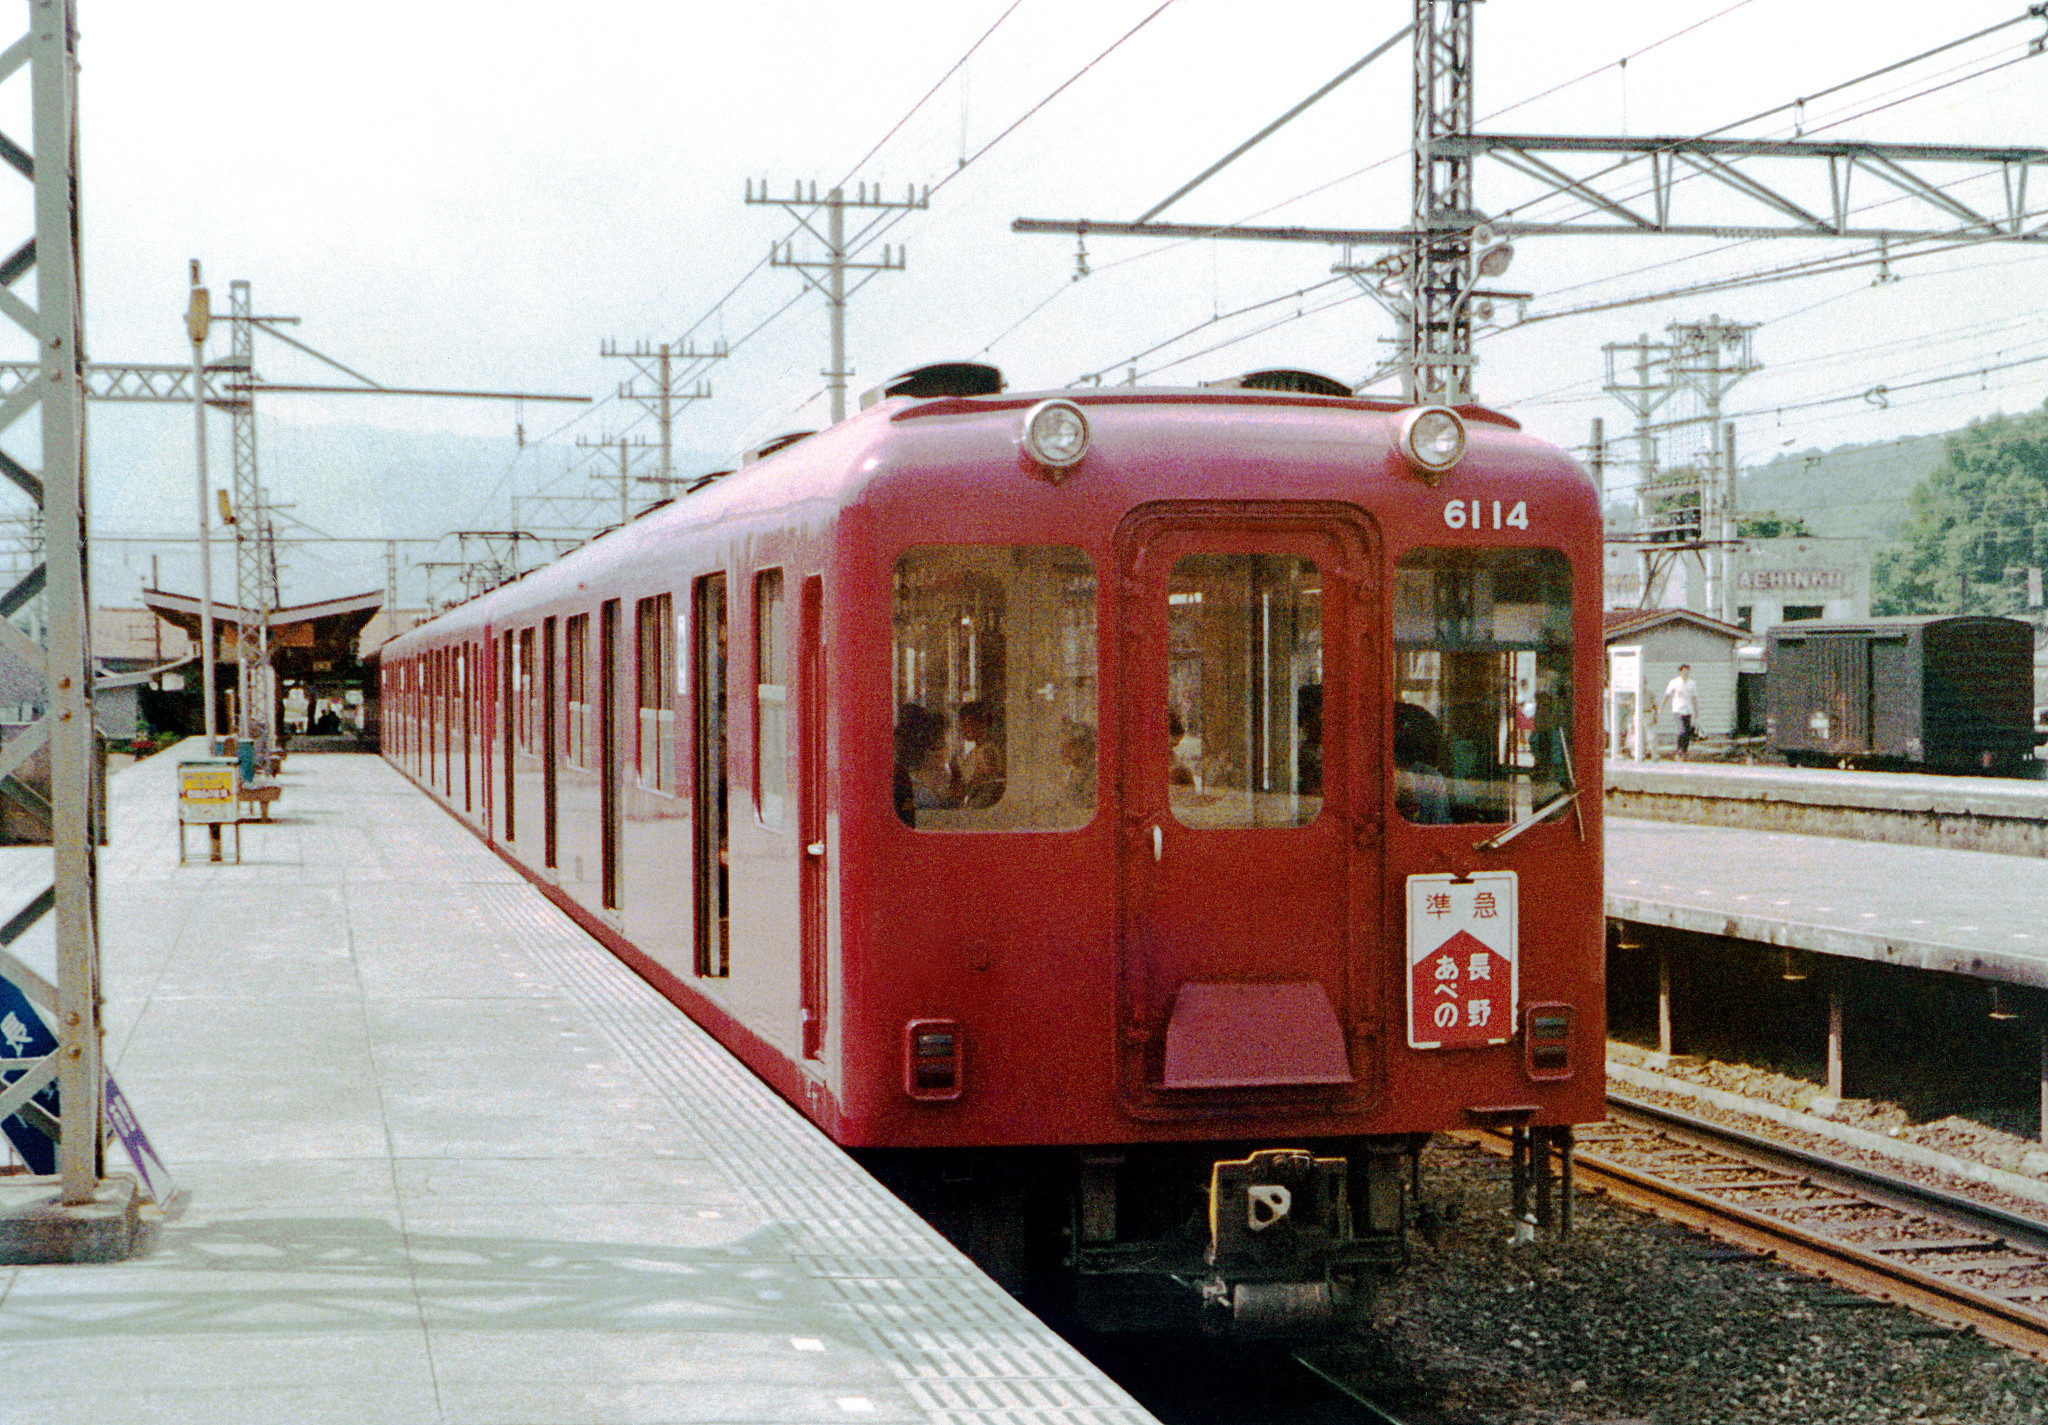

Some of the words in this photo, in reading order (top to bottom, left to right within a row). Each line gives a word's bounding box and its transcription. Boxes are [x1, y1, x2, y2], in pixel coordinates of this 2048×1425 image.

[1444, 500, 1529, 529] 6114
[1426, 892, 1498, 920] 準急
[1468, 953, 1491, 1027] 長野
